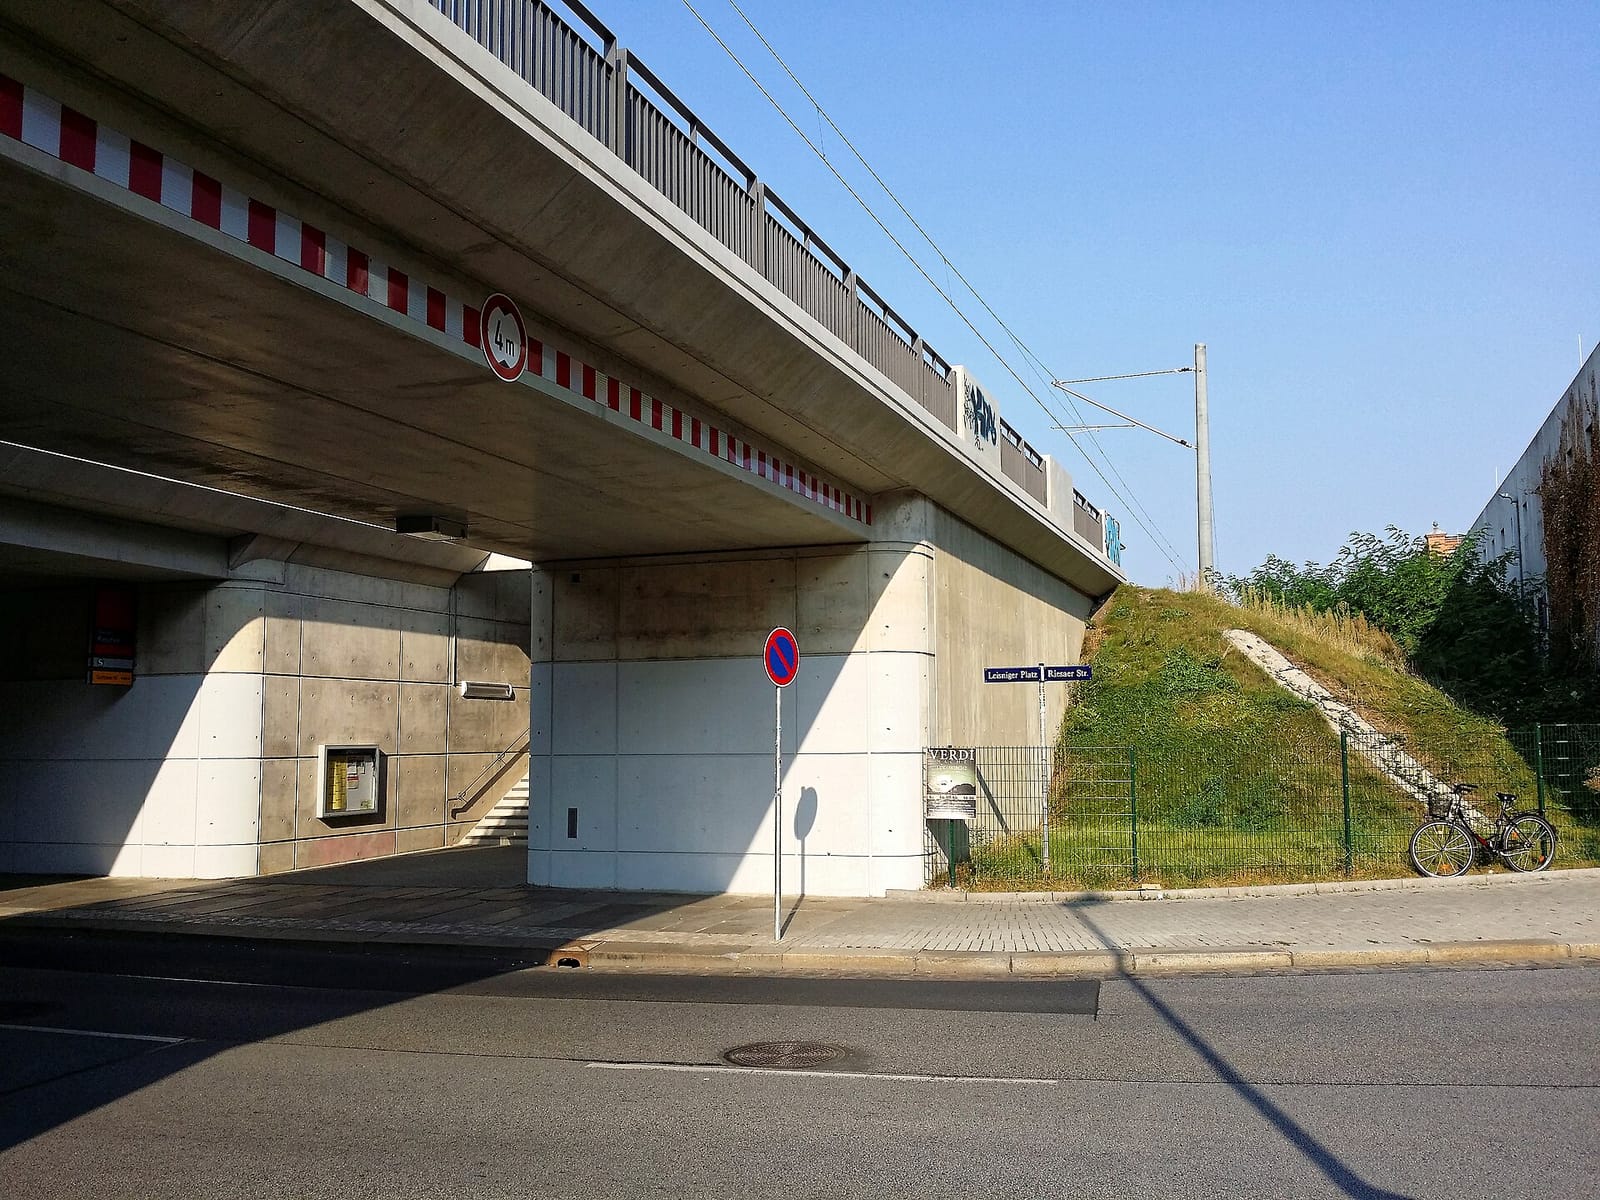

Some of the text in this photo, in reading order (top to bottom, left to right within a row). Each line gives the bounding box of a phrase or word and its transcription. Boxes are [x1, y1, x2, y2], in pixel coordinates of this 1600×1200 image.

[495, 319, 515, 358] 4 m
[988, 670, 1038, 680] Leisniger Platz
[1047, 669, 1089, 678] Riesaer Str.
[929, 749, 975, 761] VERDI
